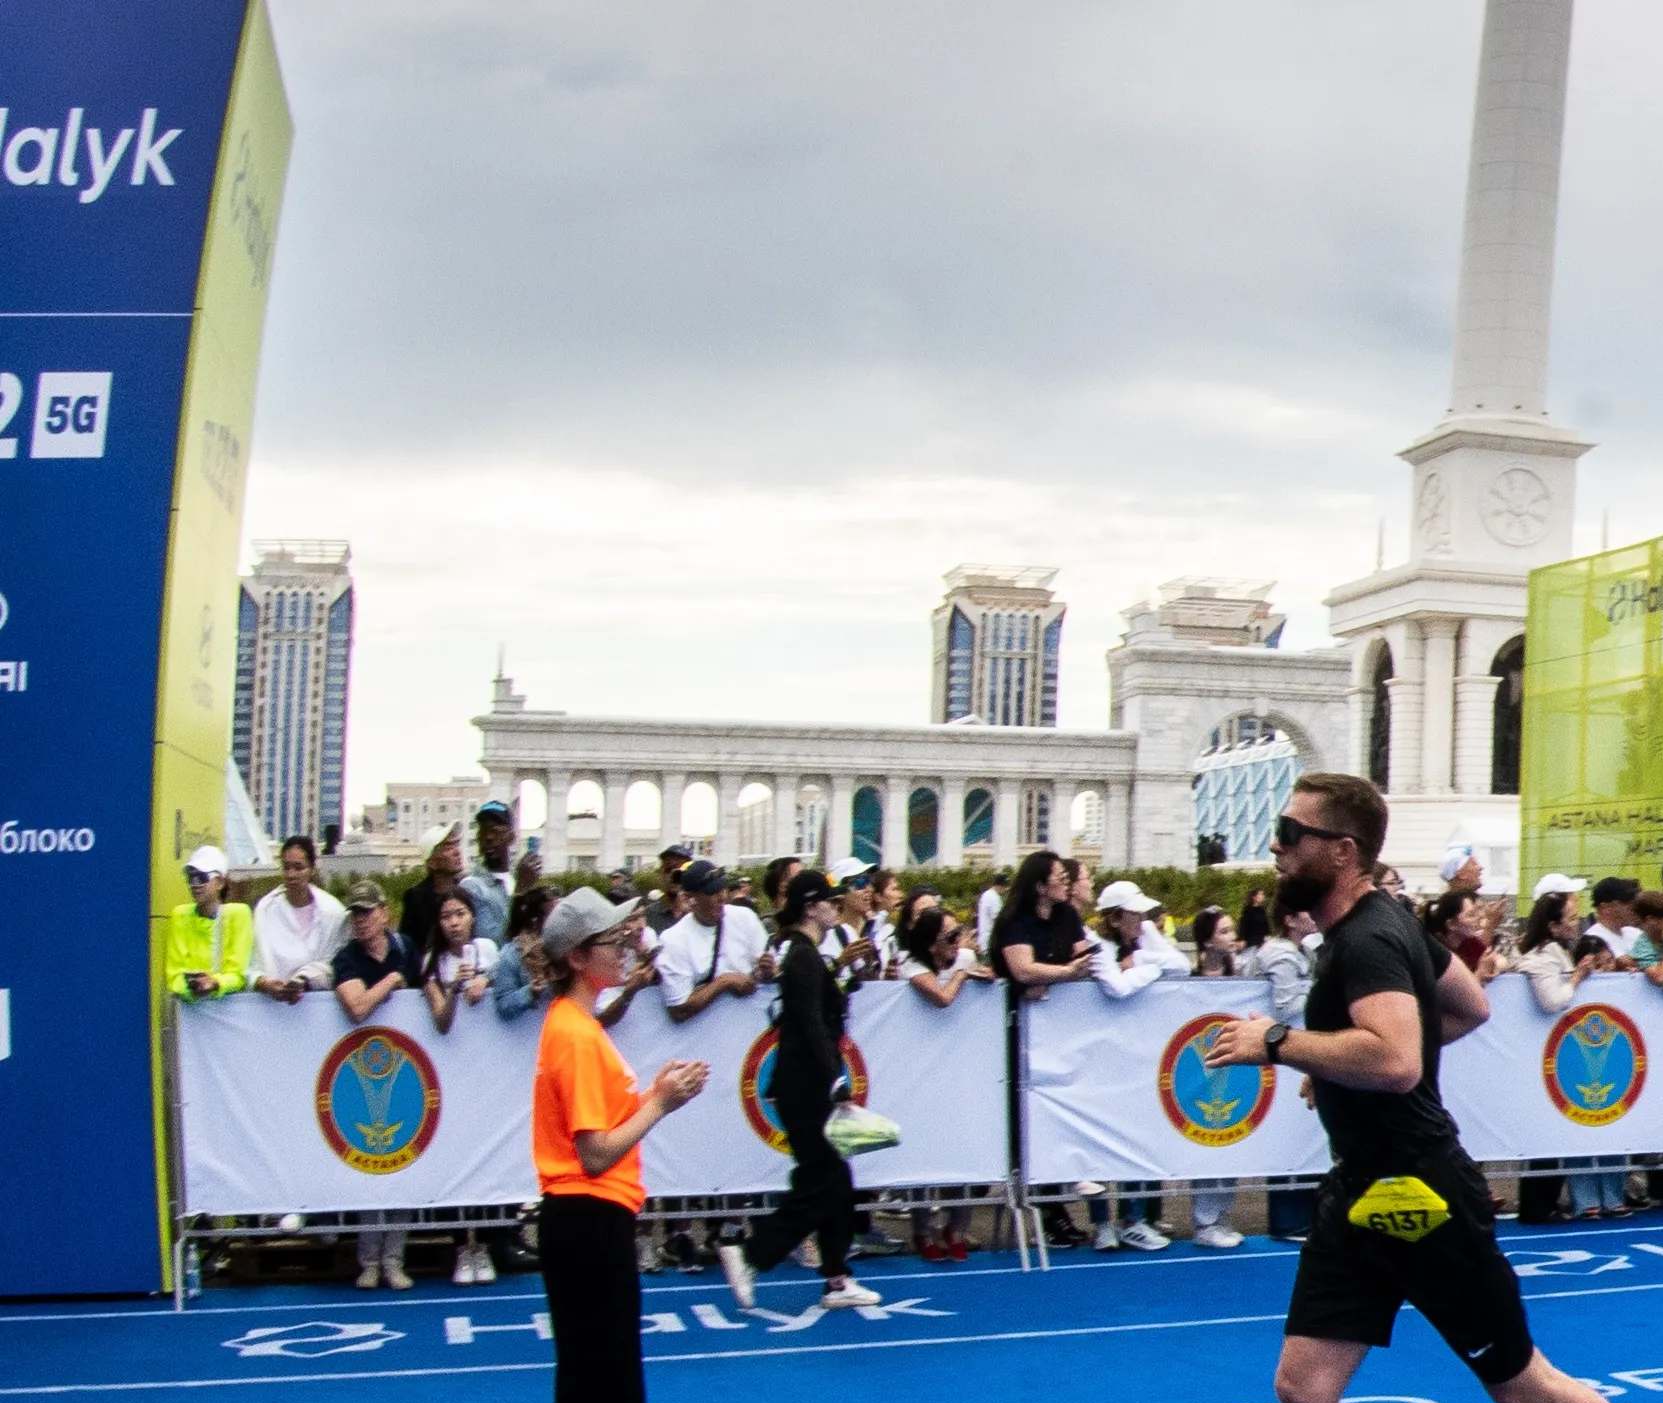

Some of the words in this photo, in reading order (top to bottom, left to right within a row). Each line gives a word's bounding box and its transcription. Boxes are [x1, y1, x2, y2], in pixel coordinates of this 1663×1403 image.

[0, 107, 185, 204] alyk
[45, 395, 99, 435] 5G
[1367, 1208, 1429, 1233] 6137
